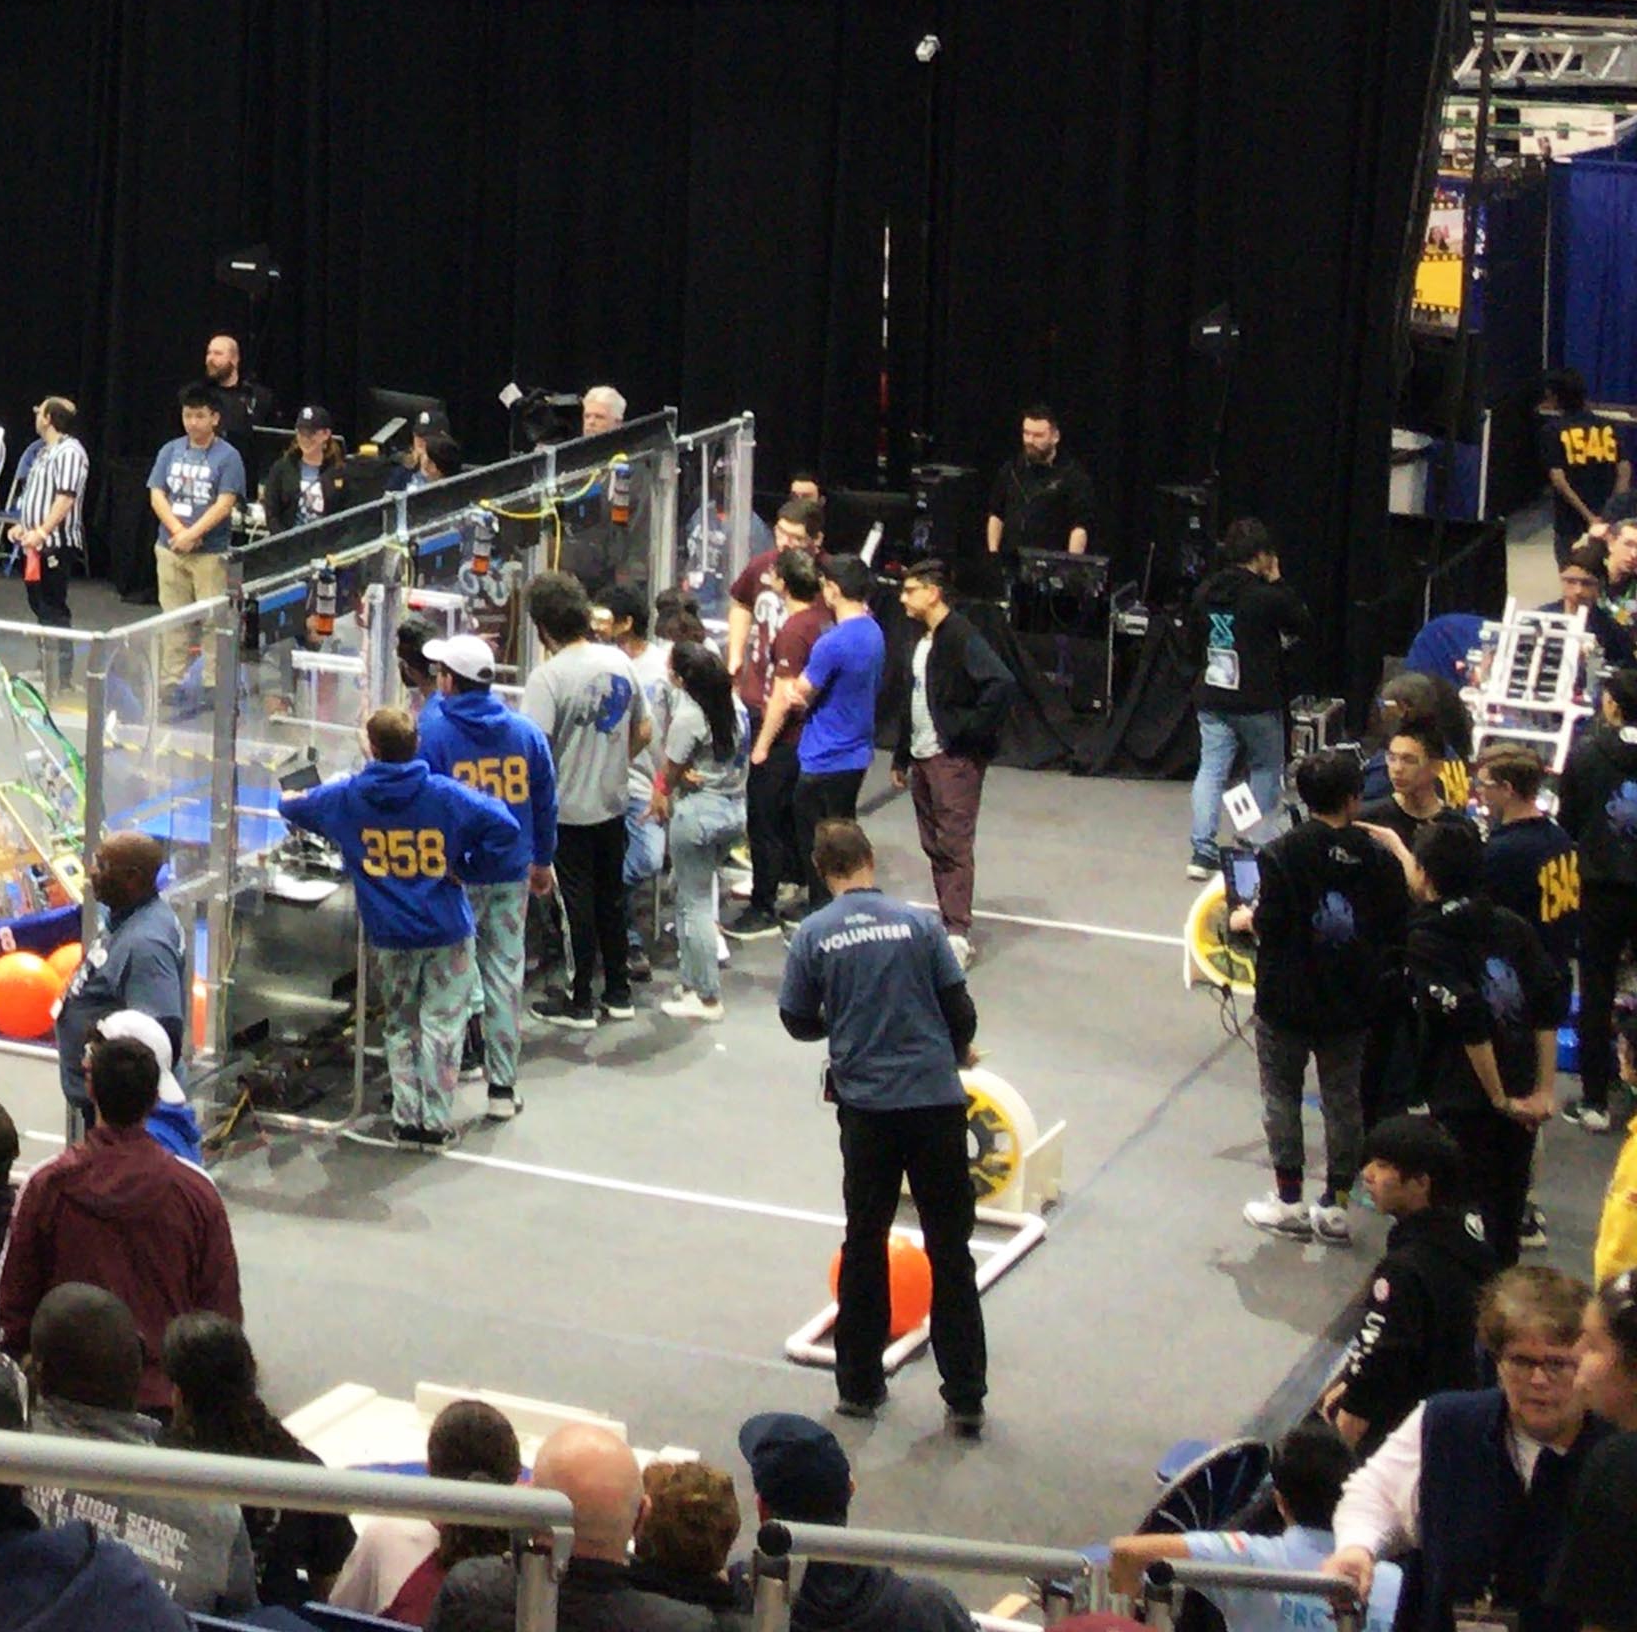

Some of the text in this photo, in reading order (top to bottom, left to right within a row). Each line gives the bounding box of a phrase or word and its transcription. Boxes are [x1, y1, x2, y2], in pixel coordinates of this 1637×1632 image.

[1559, 423, 1618, 466] 1546
[167, 481, 214, 505] SPCE
[454, 756, 530, 804] 358
[360, 827, 449, 879] 358
[819, 924, 913, 954] VOLUNTEER
[75, 1492, 118, 1524] HIGH
[126, 1511, 190, 1552] SCHOOL
